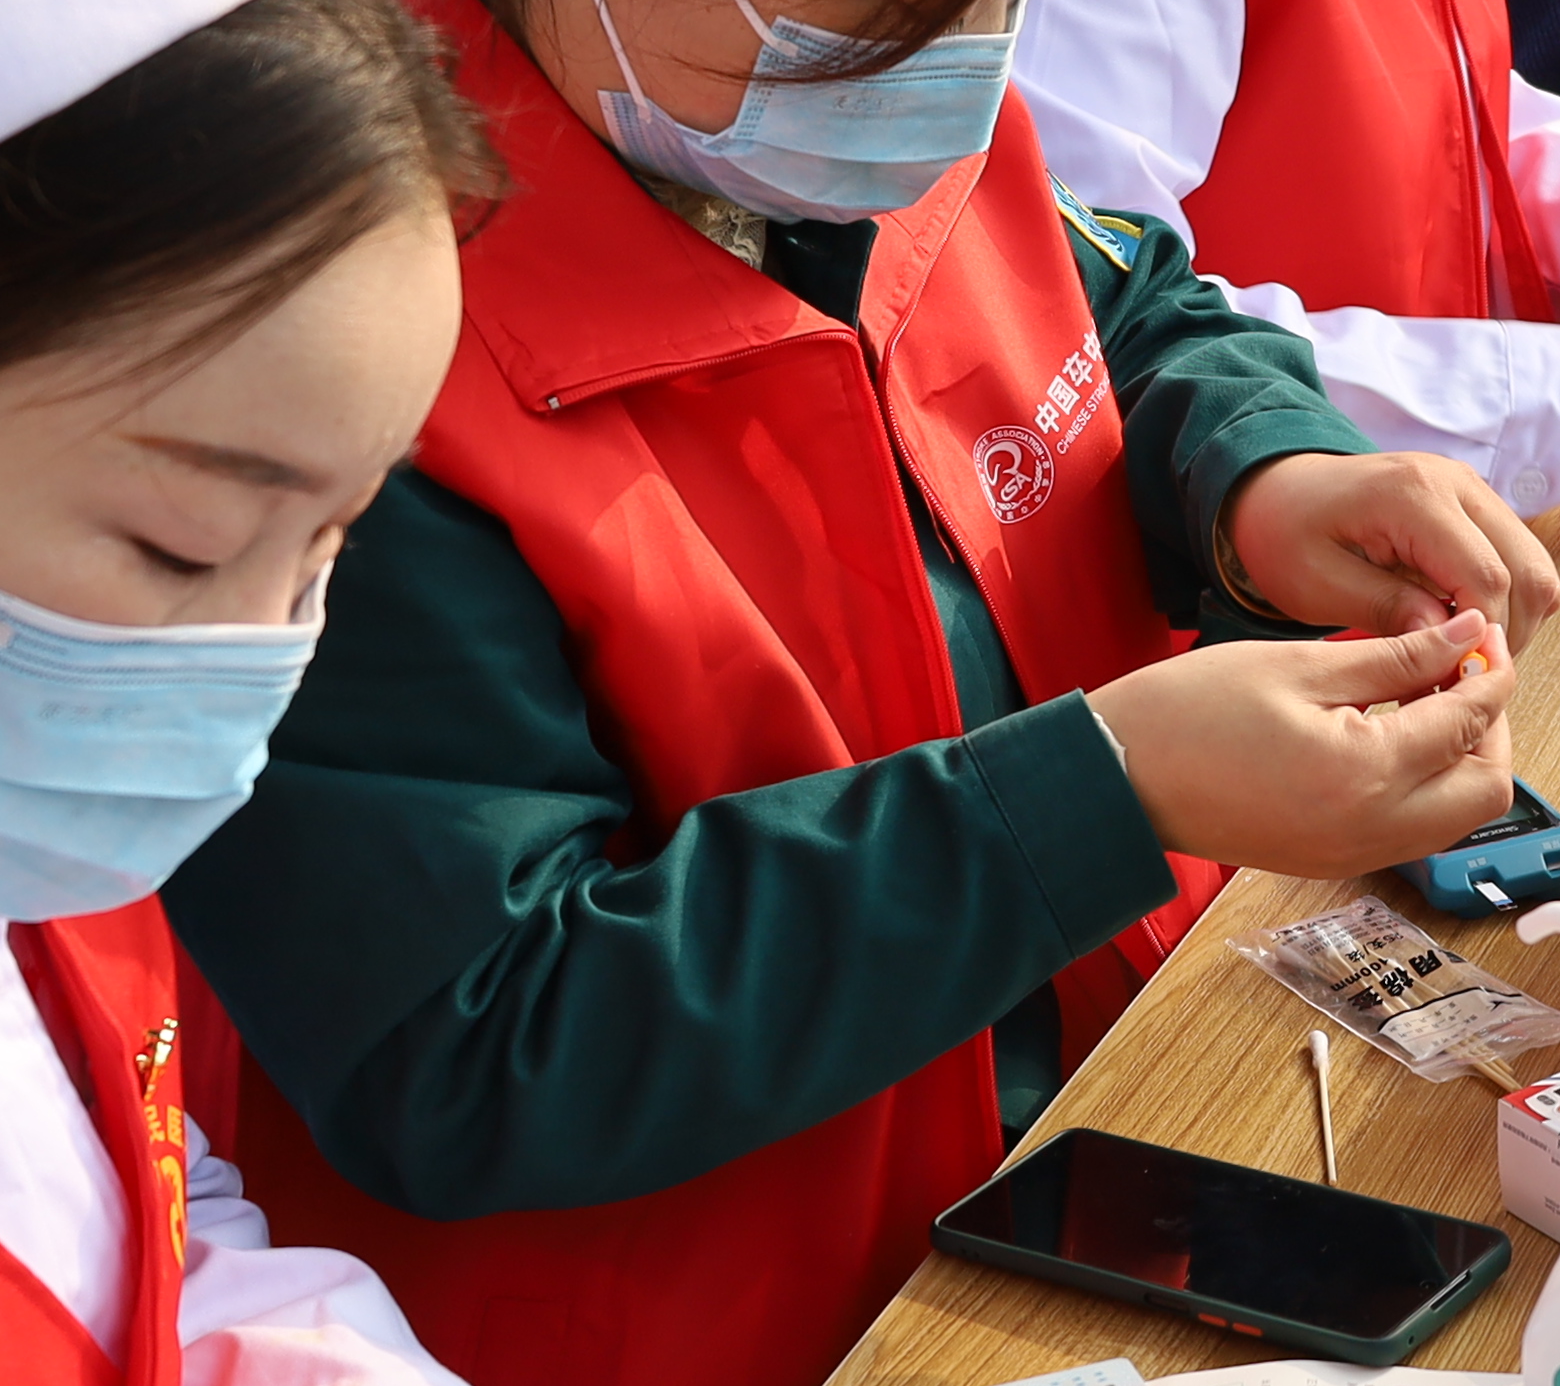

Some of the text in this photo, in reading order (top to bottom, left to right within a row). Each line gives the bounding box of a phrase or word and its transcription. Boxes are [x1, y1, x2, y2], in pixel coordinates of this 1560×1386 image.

[1034, 317, 1104, 434] 中国卒中
[1056, 407, 1093, 454] CHINESE
